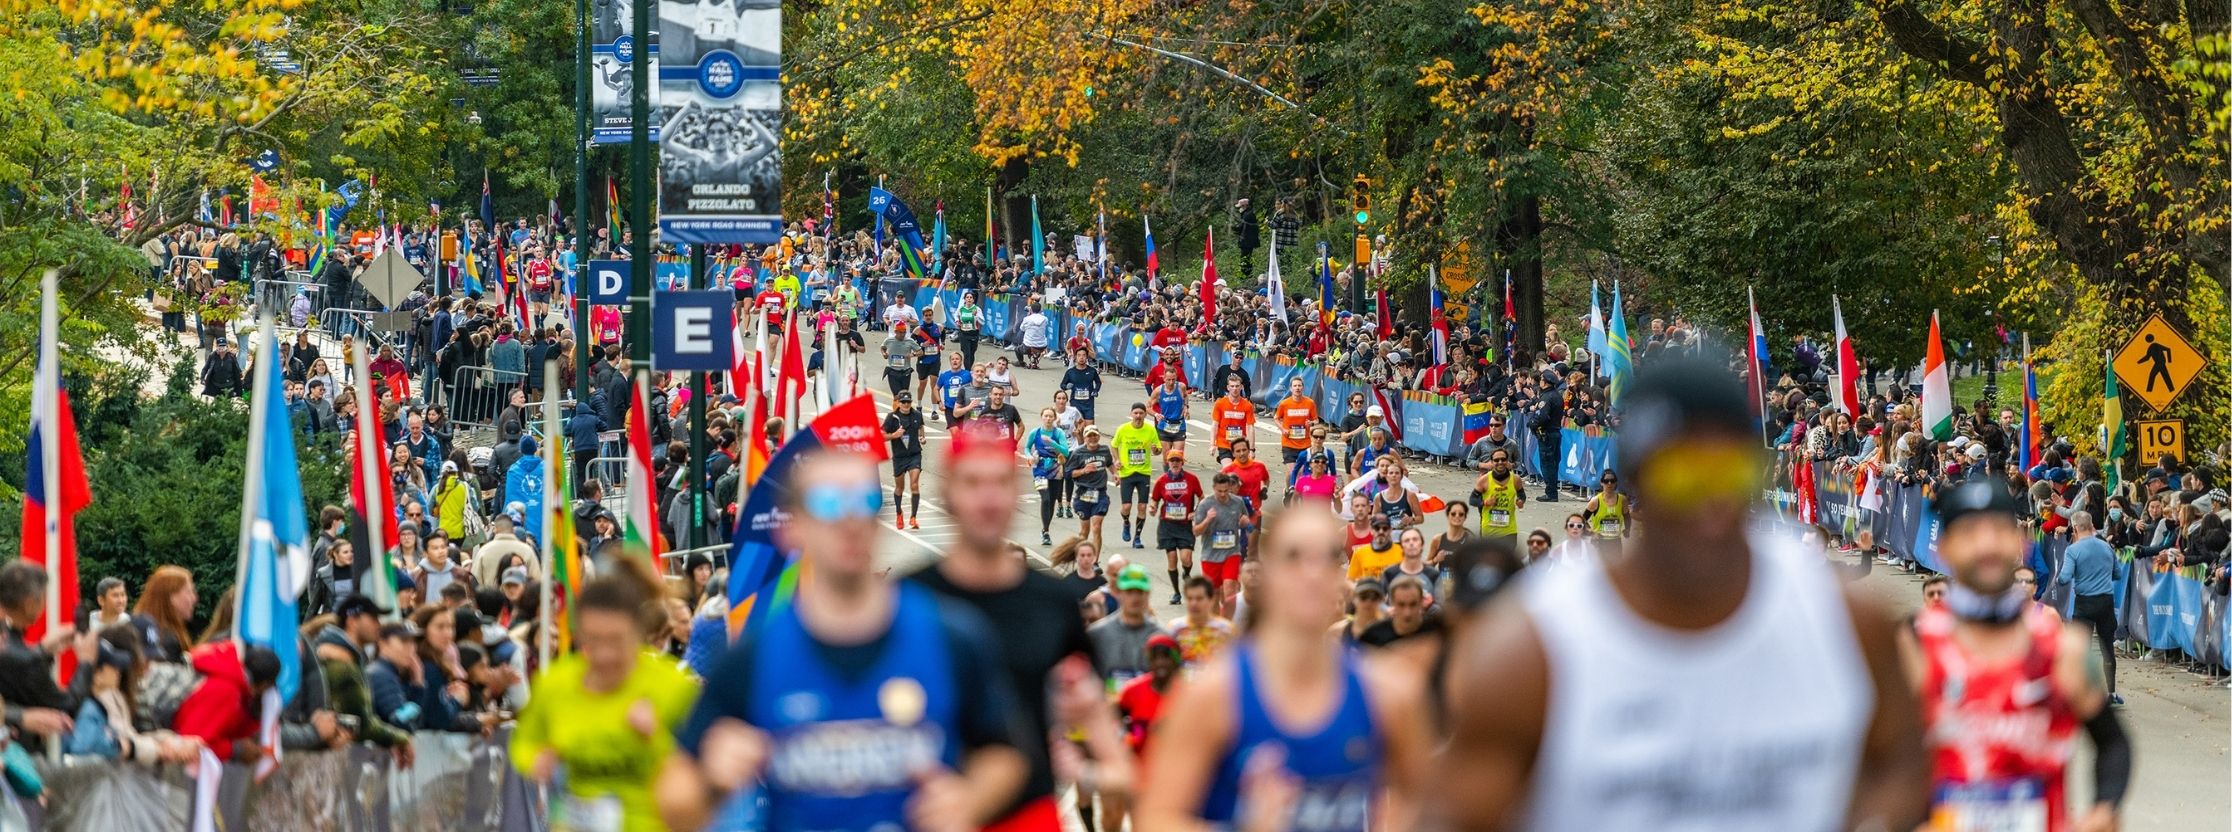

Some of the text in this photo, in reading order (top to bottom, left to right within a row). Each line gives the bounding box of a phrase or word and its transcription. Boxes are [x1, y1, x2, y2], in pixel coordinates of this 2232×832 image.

[708, 65, 733, 74] HALL
[708, 75, 733, 83] FAME
[692, 183, 751, 196] ORLANDO
[687, 198, 756, 211] PIZZOLATO
[873, 196, 886, 205] 26
[670, 221, 772, 229] NEW YORK ROAD RUNNERS
[598, 270, 623, 295] D
[1445, 271, 1473, 283] CROSSING
[674, 307, 713, 354] E
[2146, 425, 2175, 447] 10
[1830, 503, 1839, 514] 50
